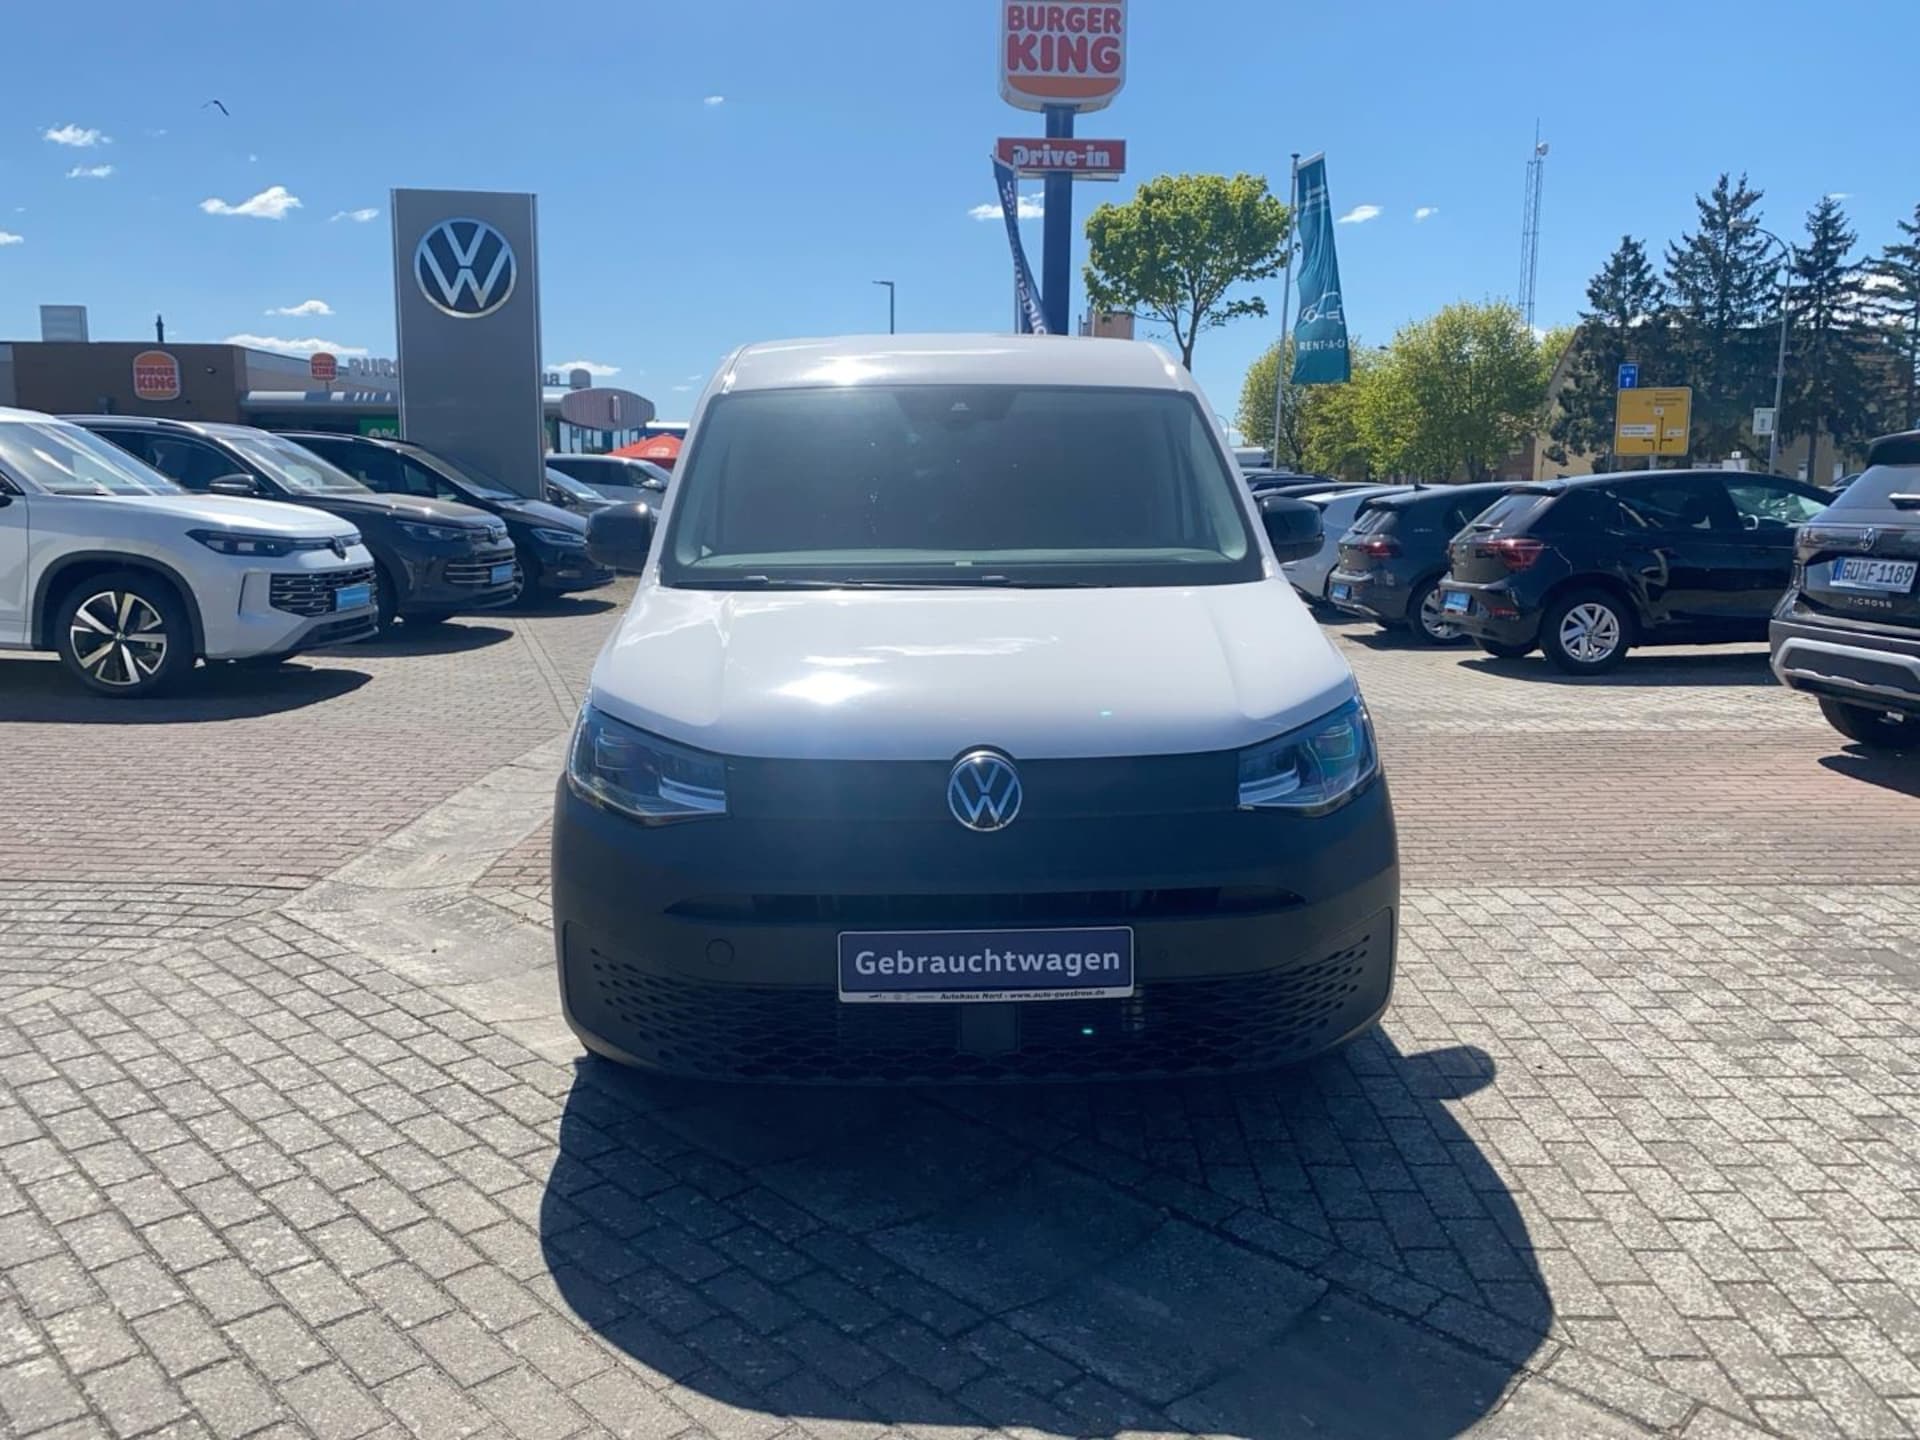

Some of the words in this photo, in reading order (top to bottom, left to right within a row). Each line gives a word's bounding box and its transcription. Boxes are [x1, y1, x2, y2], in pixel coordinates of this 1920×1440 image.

[1007, 5, 1121, 34] BURGER
[1007, 33, 1121, 73] KING
[1012, 144, 1110, 167] Drive-in
[137, 376, 177, 389] KING
[855, 948, 1120, 977] Gebrauchtwagen
